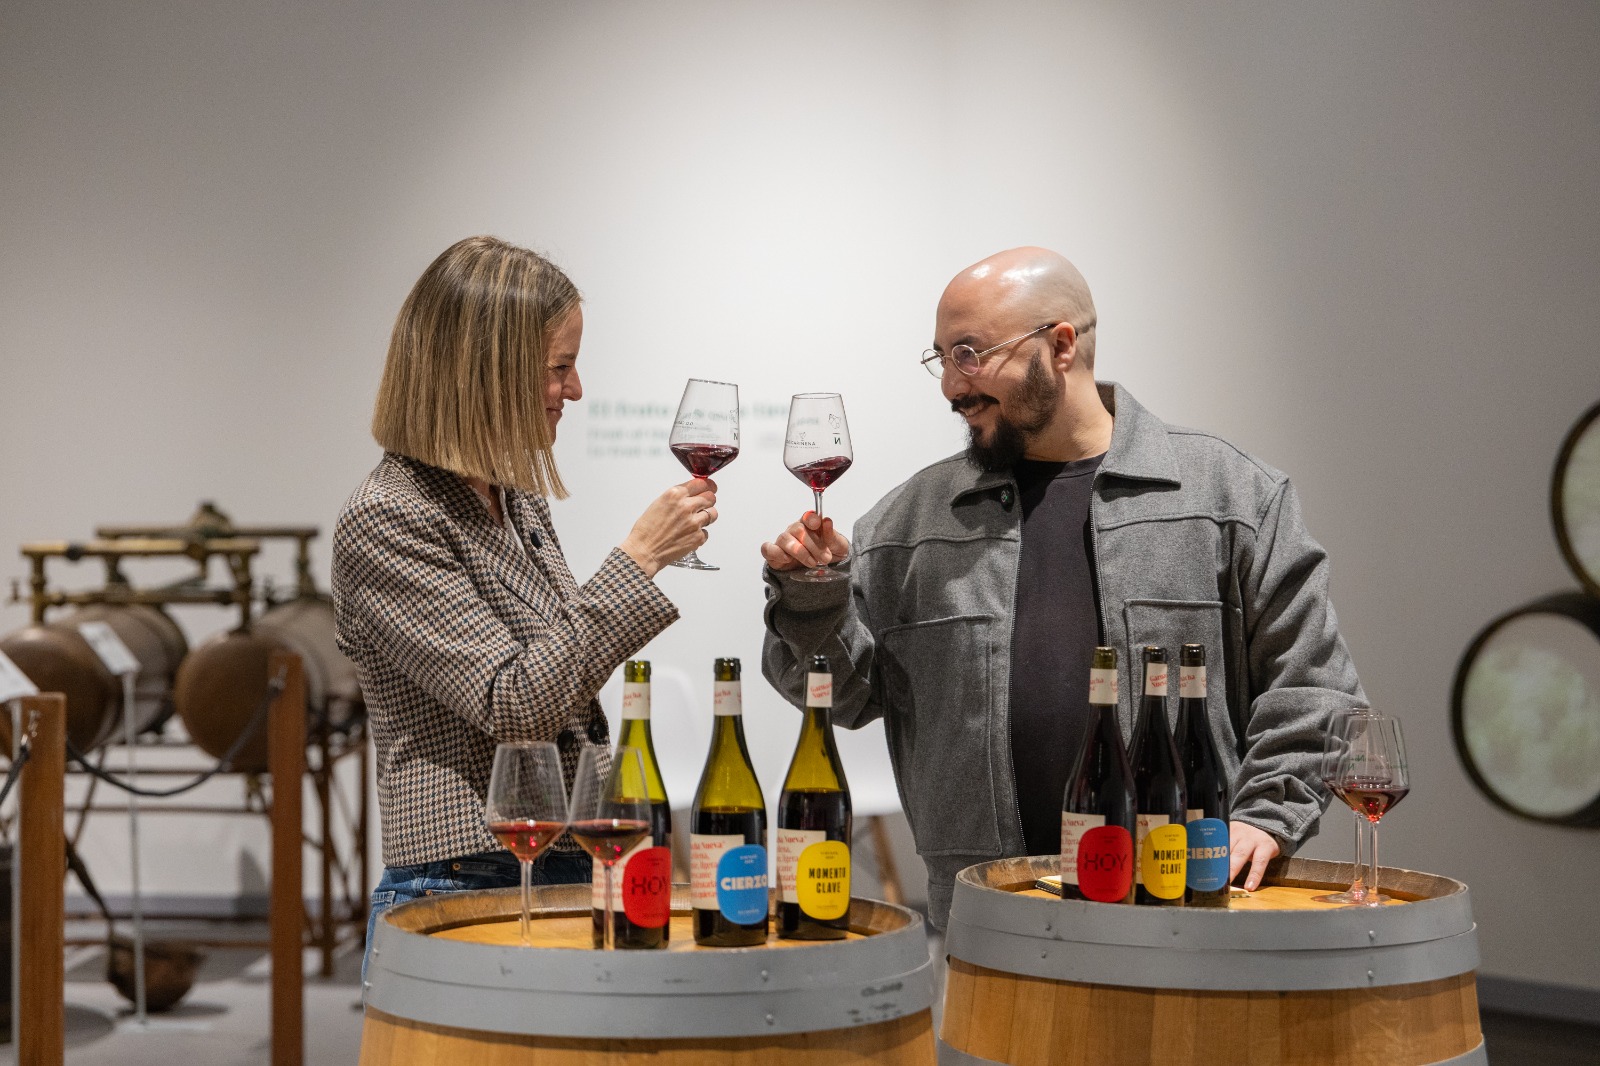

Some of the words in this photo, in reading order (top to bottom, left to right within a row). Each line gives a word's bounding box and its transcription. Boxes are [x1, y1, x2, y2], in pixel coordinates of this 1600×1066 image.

[1084, 853, 1127, 871] HOY
[808, 867, 846, 879] MOMENTO
[1160, 863, 1181, 874] CLAVE
[721, 874, 768, 891] CIERZO
[816, 882, 841, 893] CLAVE
